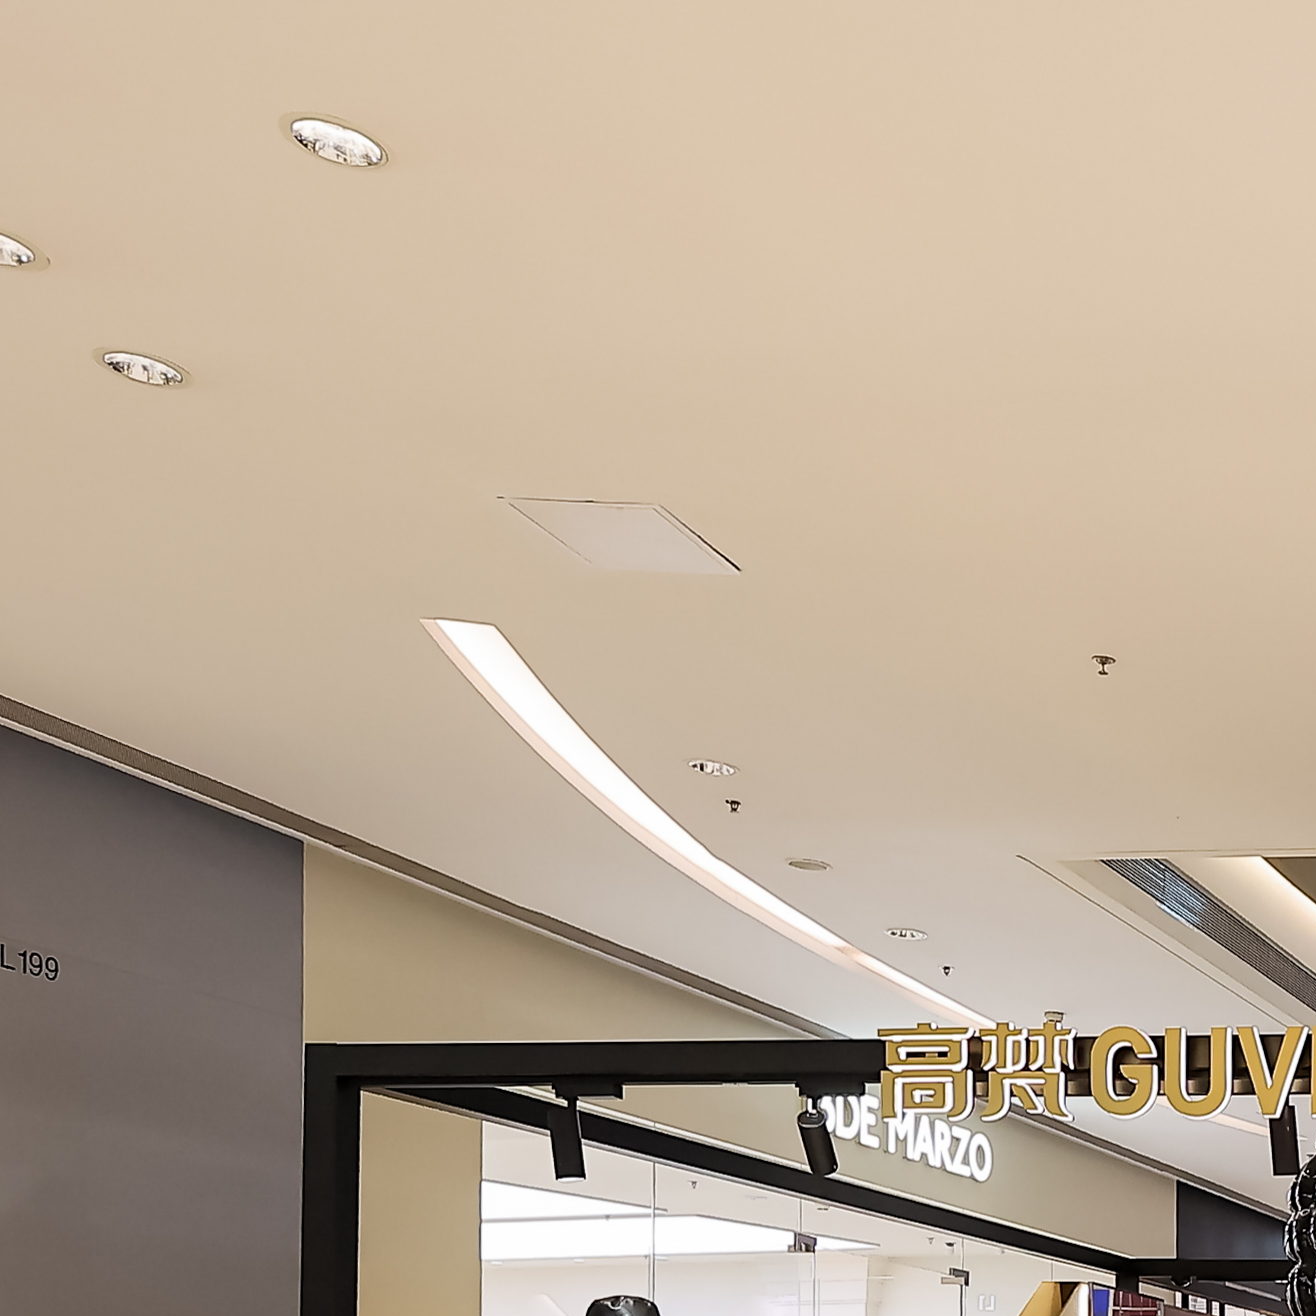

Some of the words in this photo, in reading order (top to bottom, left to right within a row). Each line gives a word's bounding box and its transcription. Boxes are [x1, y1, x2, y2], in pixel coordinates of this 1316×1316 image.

[0, 943, 60, 981] L199
[877, 1022, 1076, 1122] 高梵
[886, 1111, 993, 1183] MARZO
